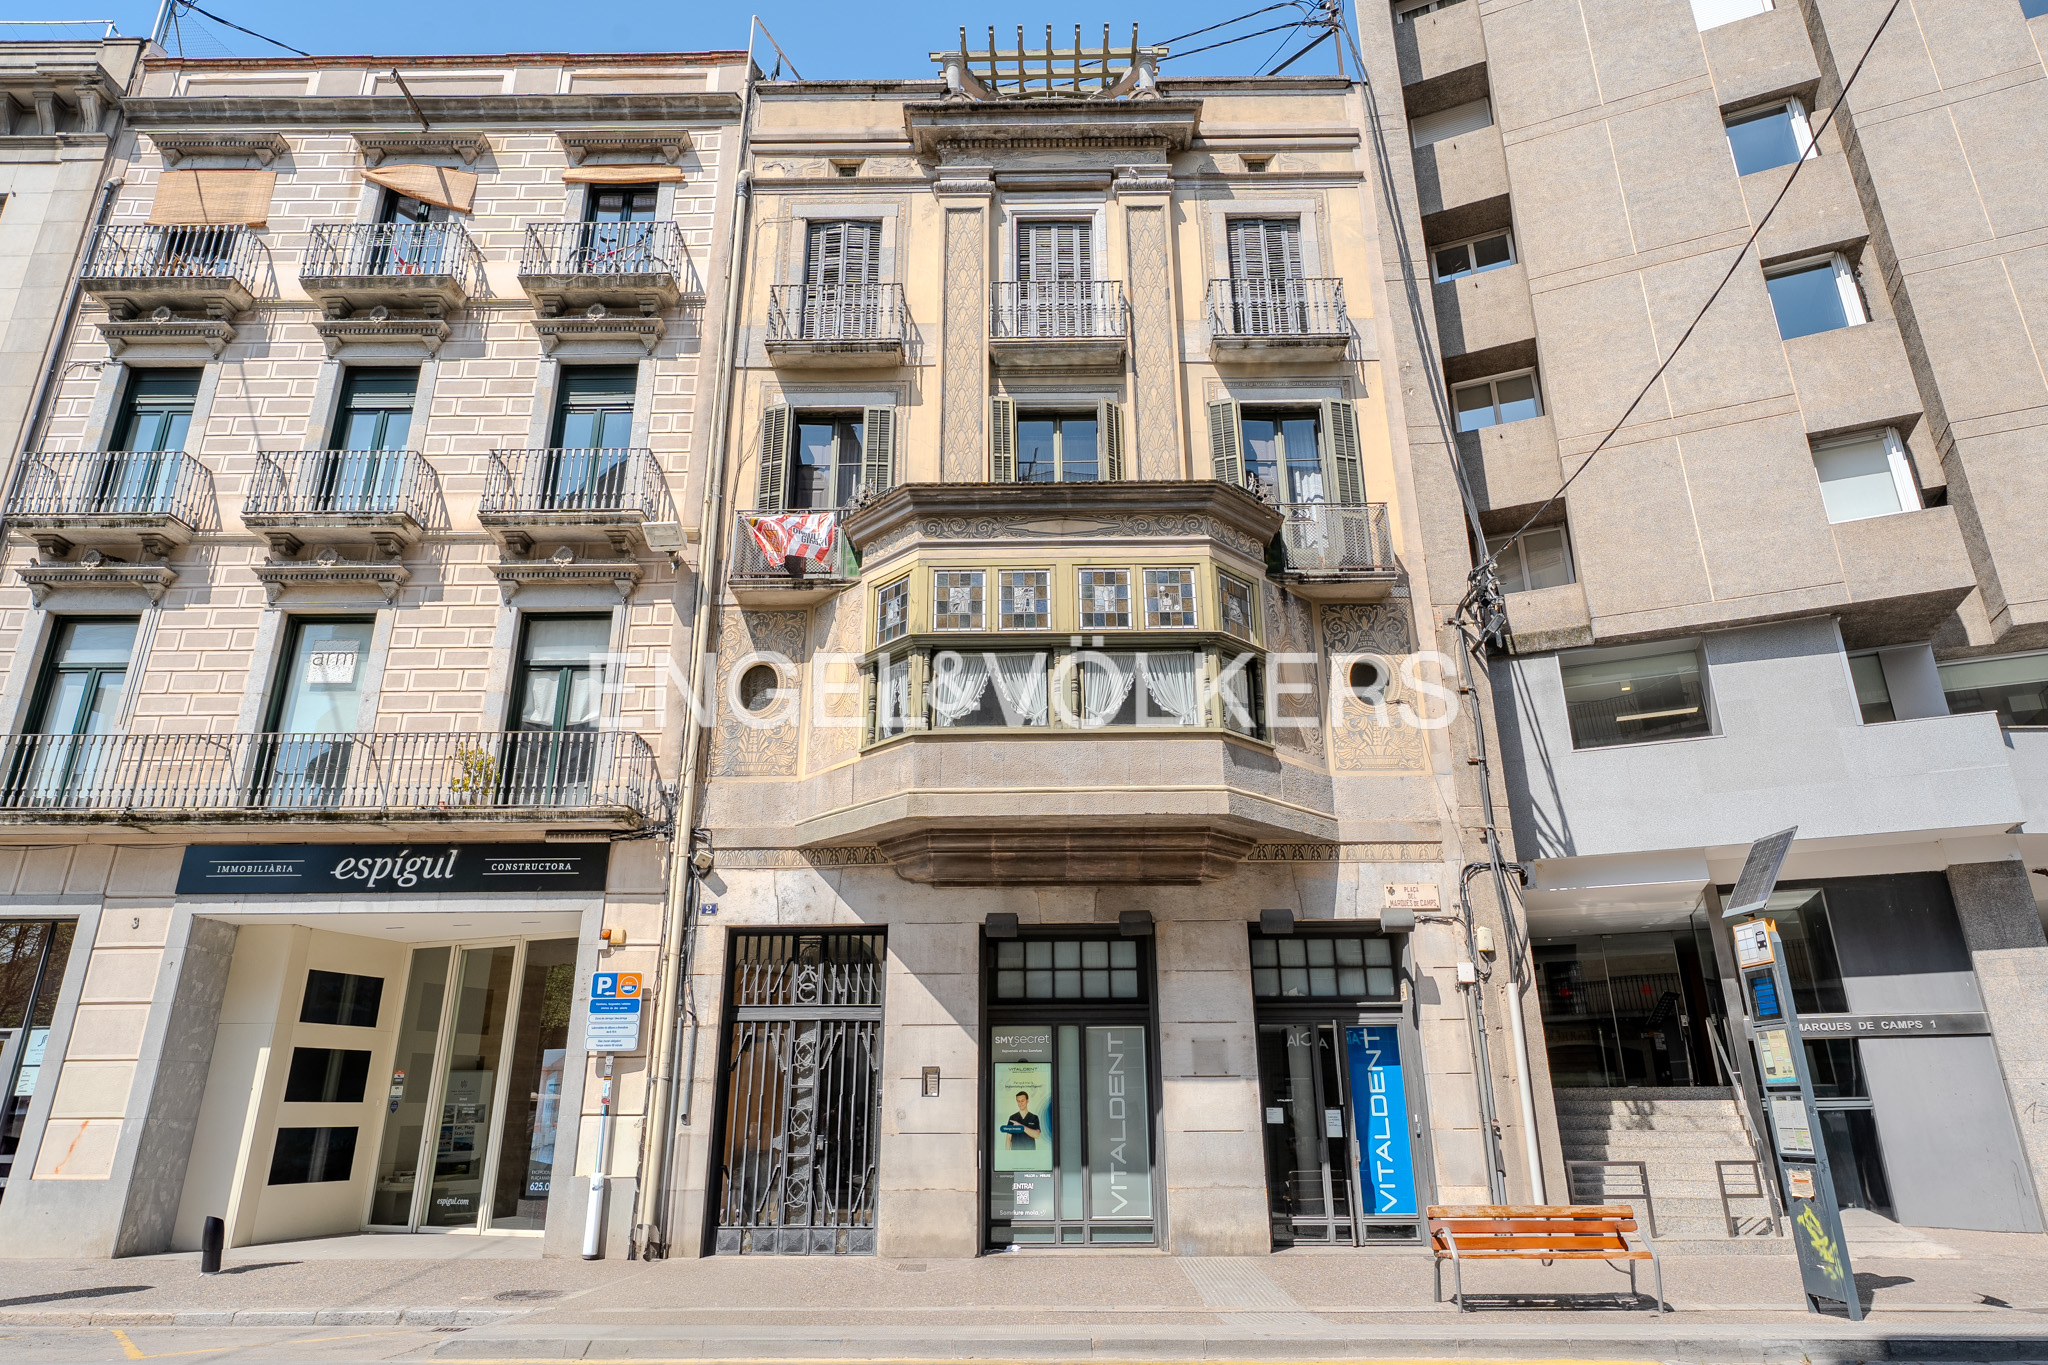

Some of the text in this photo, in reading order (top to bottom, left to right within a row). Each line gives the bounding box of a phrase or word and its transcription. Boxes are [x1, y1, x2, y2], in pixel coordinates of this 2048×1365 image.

[313, 652, 354, 665] arm
[217, 864, 293, 873] IMMOBILIÀRIA
[330, 850, 458, 888] espígul
[491, 862, 572, 871] CONSTRUCTORA
[706, 904, 712, 914] 2
[131, 917, 140, 930] 3
[597, 976, 612, 995] P
[1798, 1020, 1936, 1032] MARQUES DE CAMPS 1
[1107, 1032, 1128, 1213] VITALDENT
[1363, 1028, 1397, 1212] VITALDENT
